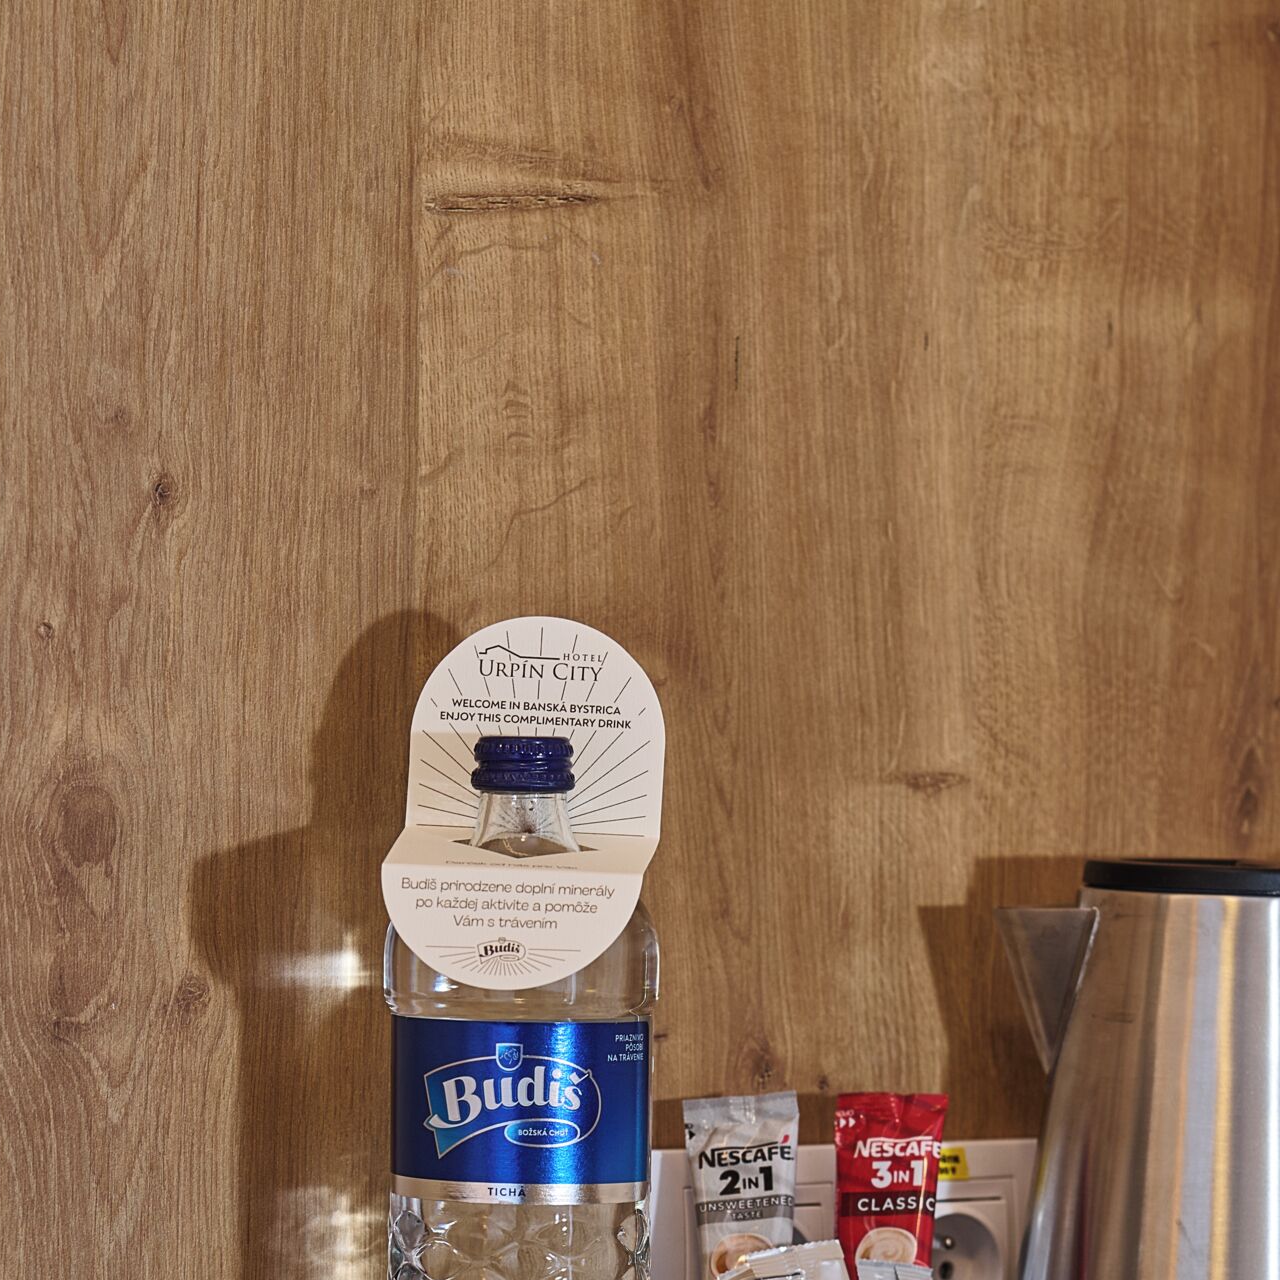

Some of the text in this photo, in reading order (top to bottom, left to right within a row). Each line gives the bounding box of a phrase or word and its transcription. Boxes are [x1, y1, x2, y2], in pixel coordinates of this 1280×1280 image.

[563, 653, 603, 663] HOTEL
[552, 663, 603, 682] CITY
[452, 698, 621, 715] WELCOME IN BANSKÁ BYSTRICA
[440, 711, 632, 729] ENJOY THIS COMPLIMENTARY DRINK
[401, 877, 615, 899] Budiš prirodzene doplní minerály
[415, 897, 598, 915] po každej aktivite a pomôže
[453, 914, 558, 929] Vám s trávením
[479, 942, 521, 958] Budiš
[615, 1033, 644, 1043] PRIAZNIVO
[607, 1054, 618, 1062] NA
[428, 1066, 589, 1128] Budiš
[518, 1127, 548, 1137] BOŽSKÁ
[487, 1186, 527, 1197] TICHÁ
[732, 1211, 762, 1220] TASTE
